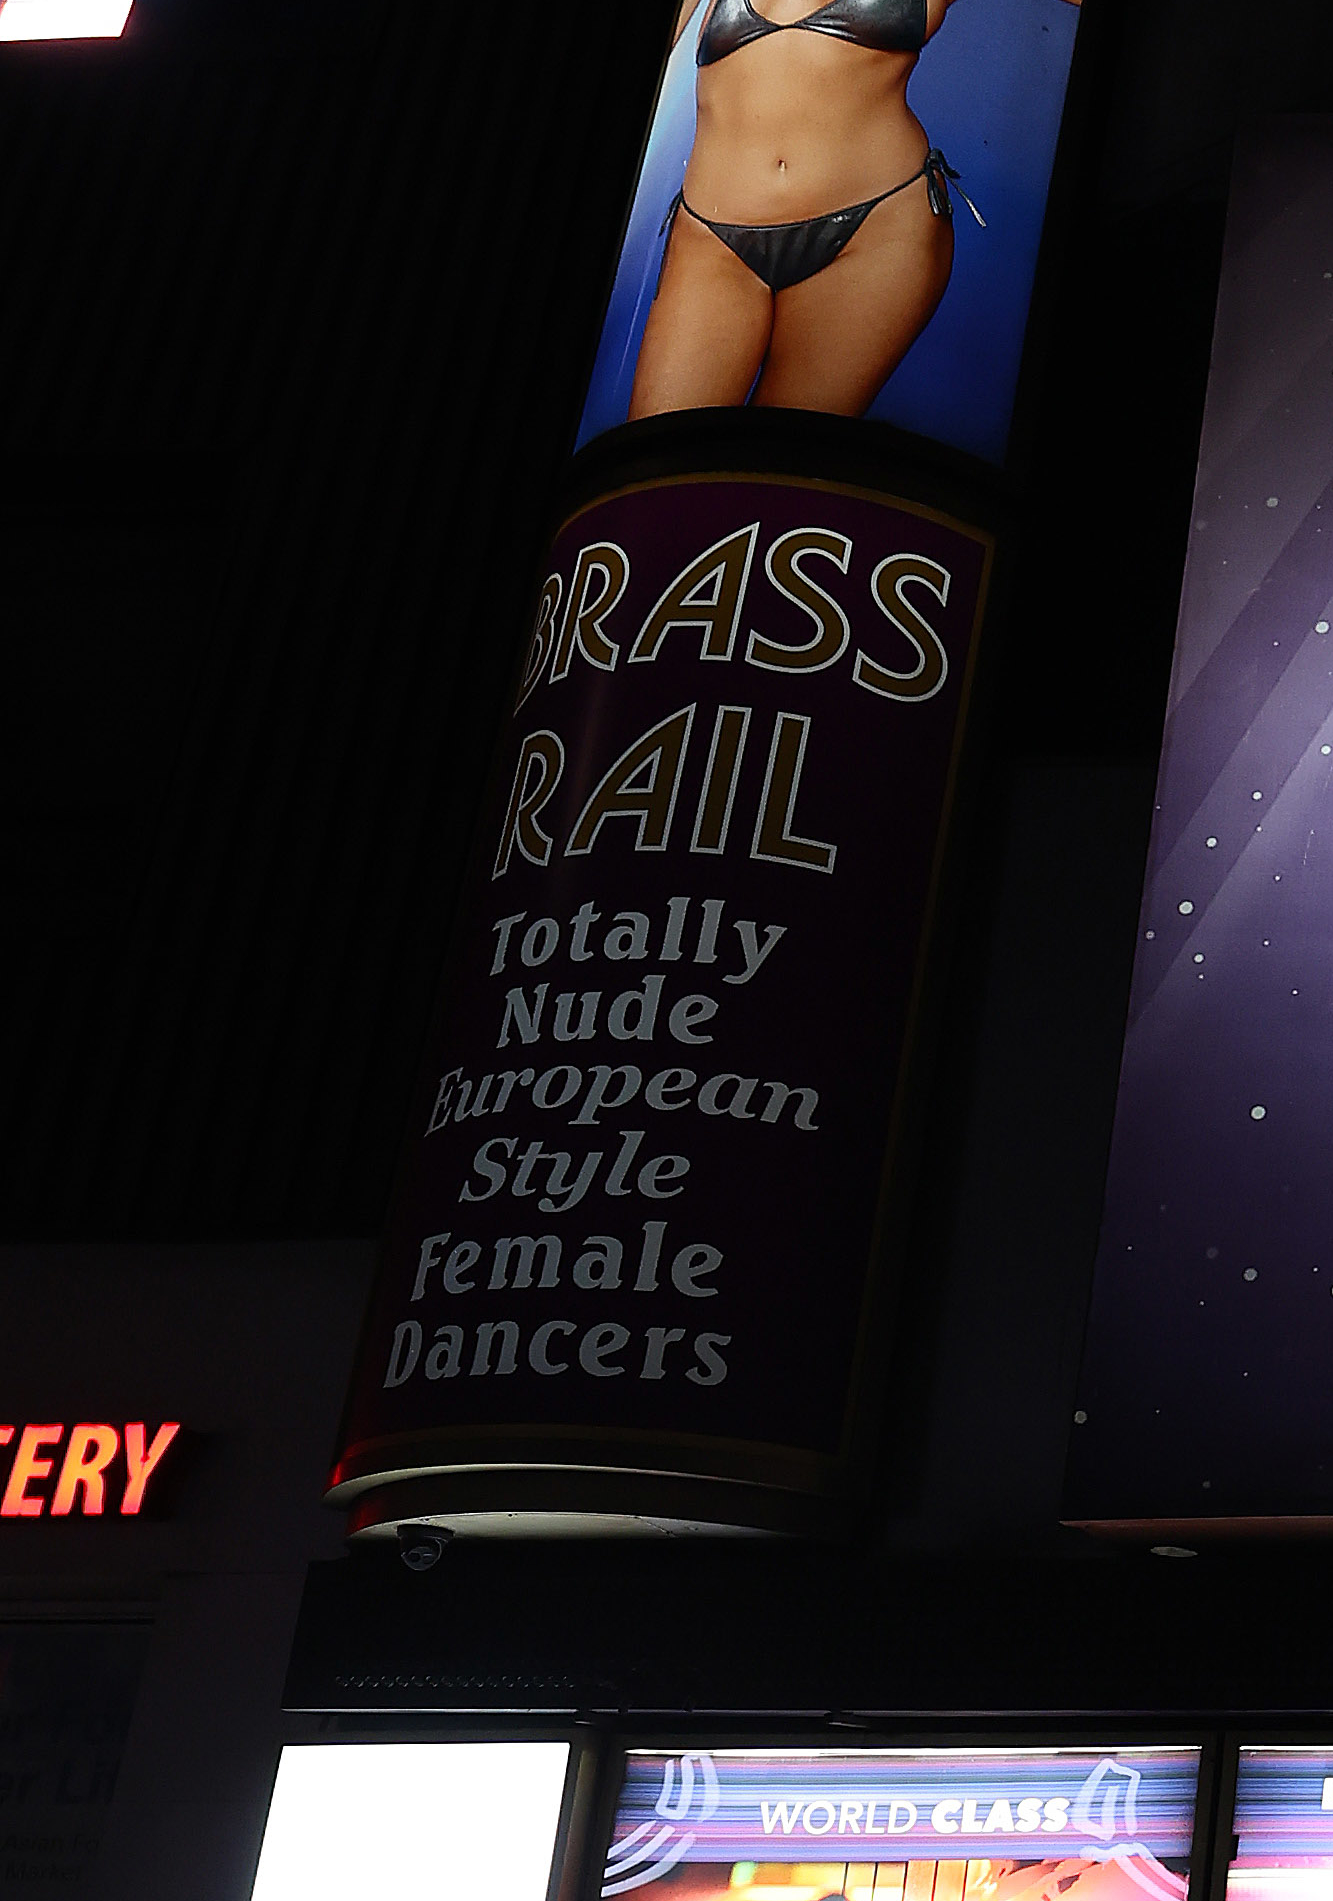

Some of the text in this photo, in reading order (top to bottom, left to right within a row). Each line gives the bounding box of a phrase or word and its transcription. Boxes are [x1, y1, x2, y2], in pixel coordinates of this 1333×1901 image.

[512, 521, 953, 716] BRASS
[491, 703, 838, 881] RAIL
[489, 896, 788, 984] Totally
[496, 975, 719, 1050] Nude
[425, 1062, 822, 1141] European
[458, 1129, 692, 1214] Style
[410, 1220, 725, 1302] Female
[383, 1318, 731, 1391] Dancers
[759, 1798, 1070, 1835] WORLD CLASS
